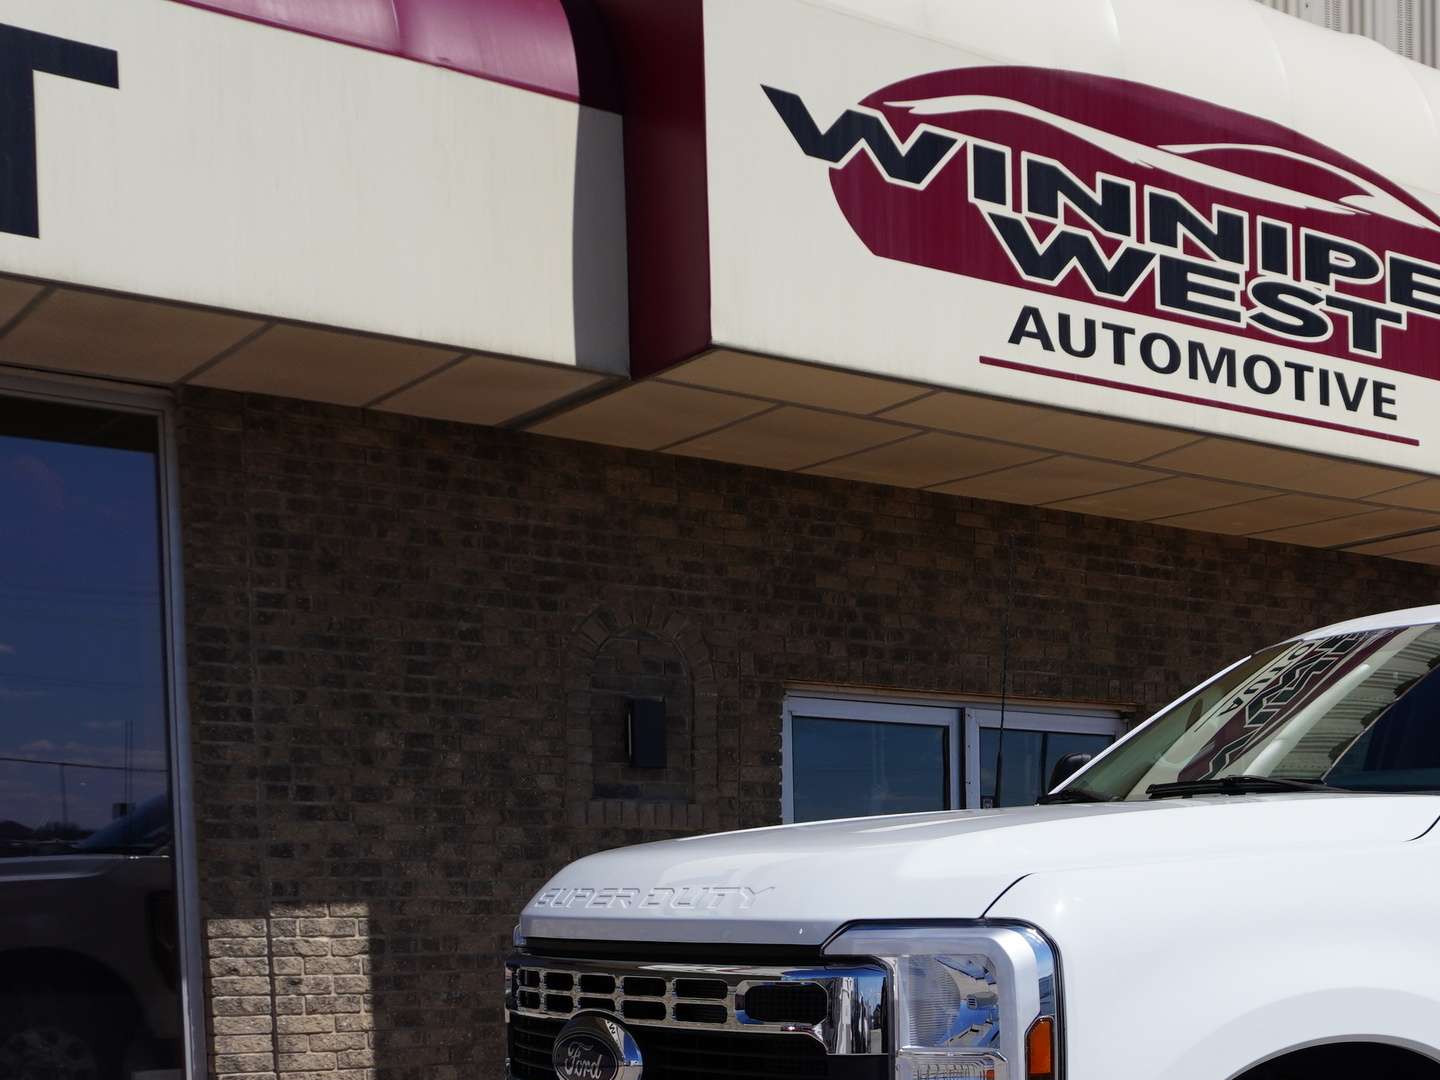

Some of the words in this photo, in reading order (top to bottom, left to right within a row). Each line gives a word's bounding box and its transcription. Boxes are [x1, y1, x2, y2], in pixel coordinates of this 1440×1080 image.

[987, 212, 1403, 356] WEST
[1008, 305, 1399, 421] AUTOMOTIVE
[533, 887, 641, 909] SUPER
[638, 886, 776, 909] DUTY
[563, 1040, 603, 1080] Ford
